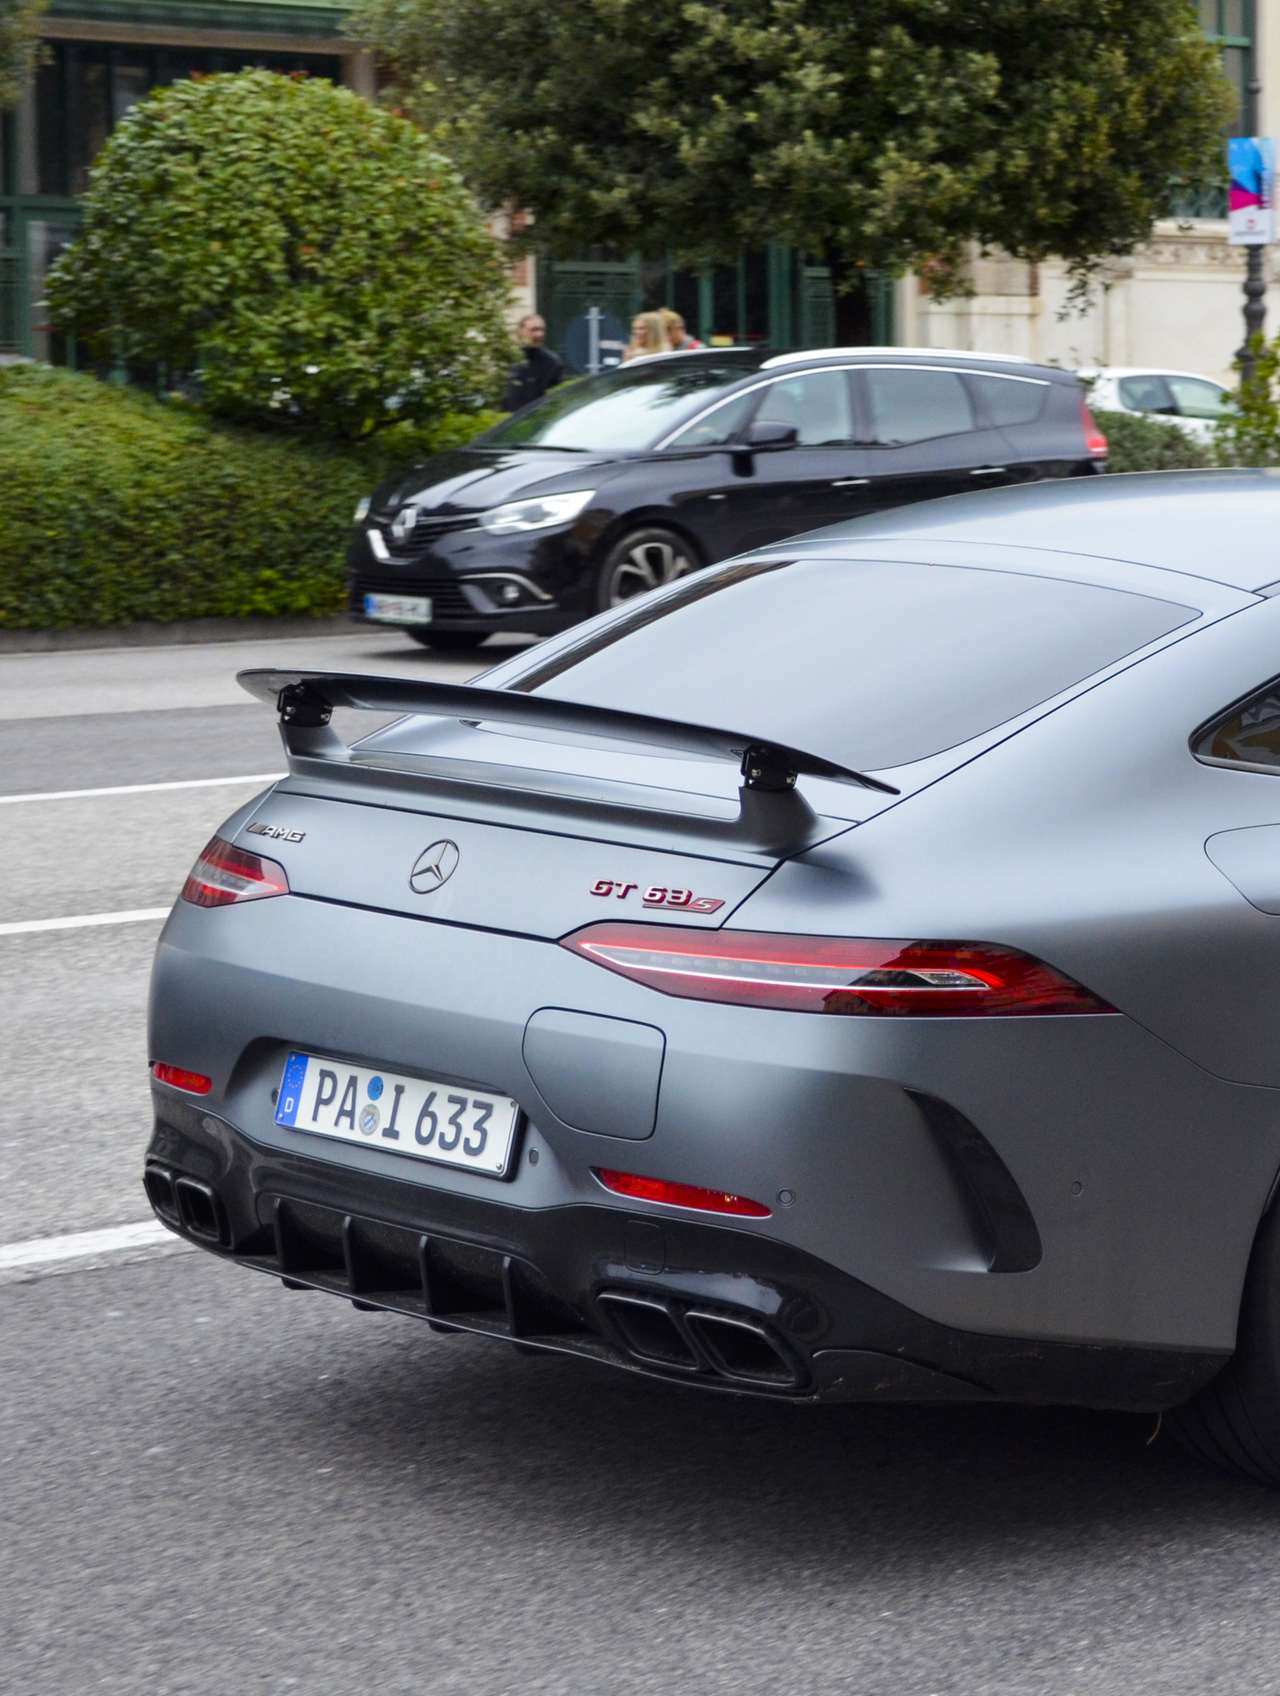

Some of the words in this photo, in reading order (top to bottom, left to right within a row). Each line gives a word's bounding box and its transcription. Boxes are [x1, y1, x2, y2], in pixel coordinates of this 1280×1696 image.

[260, 825, 306, 843] AMG
[590, 879, 638, 899] GT
[642, 886, 693, 906] 63
[284, 1097, 294, 1113] D
[311, 1068, 358, 1130] PA
[382, 1084, 405, 1140] I
[414, 1091, 494, 1157] 633
